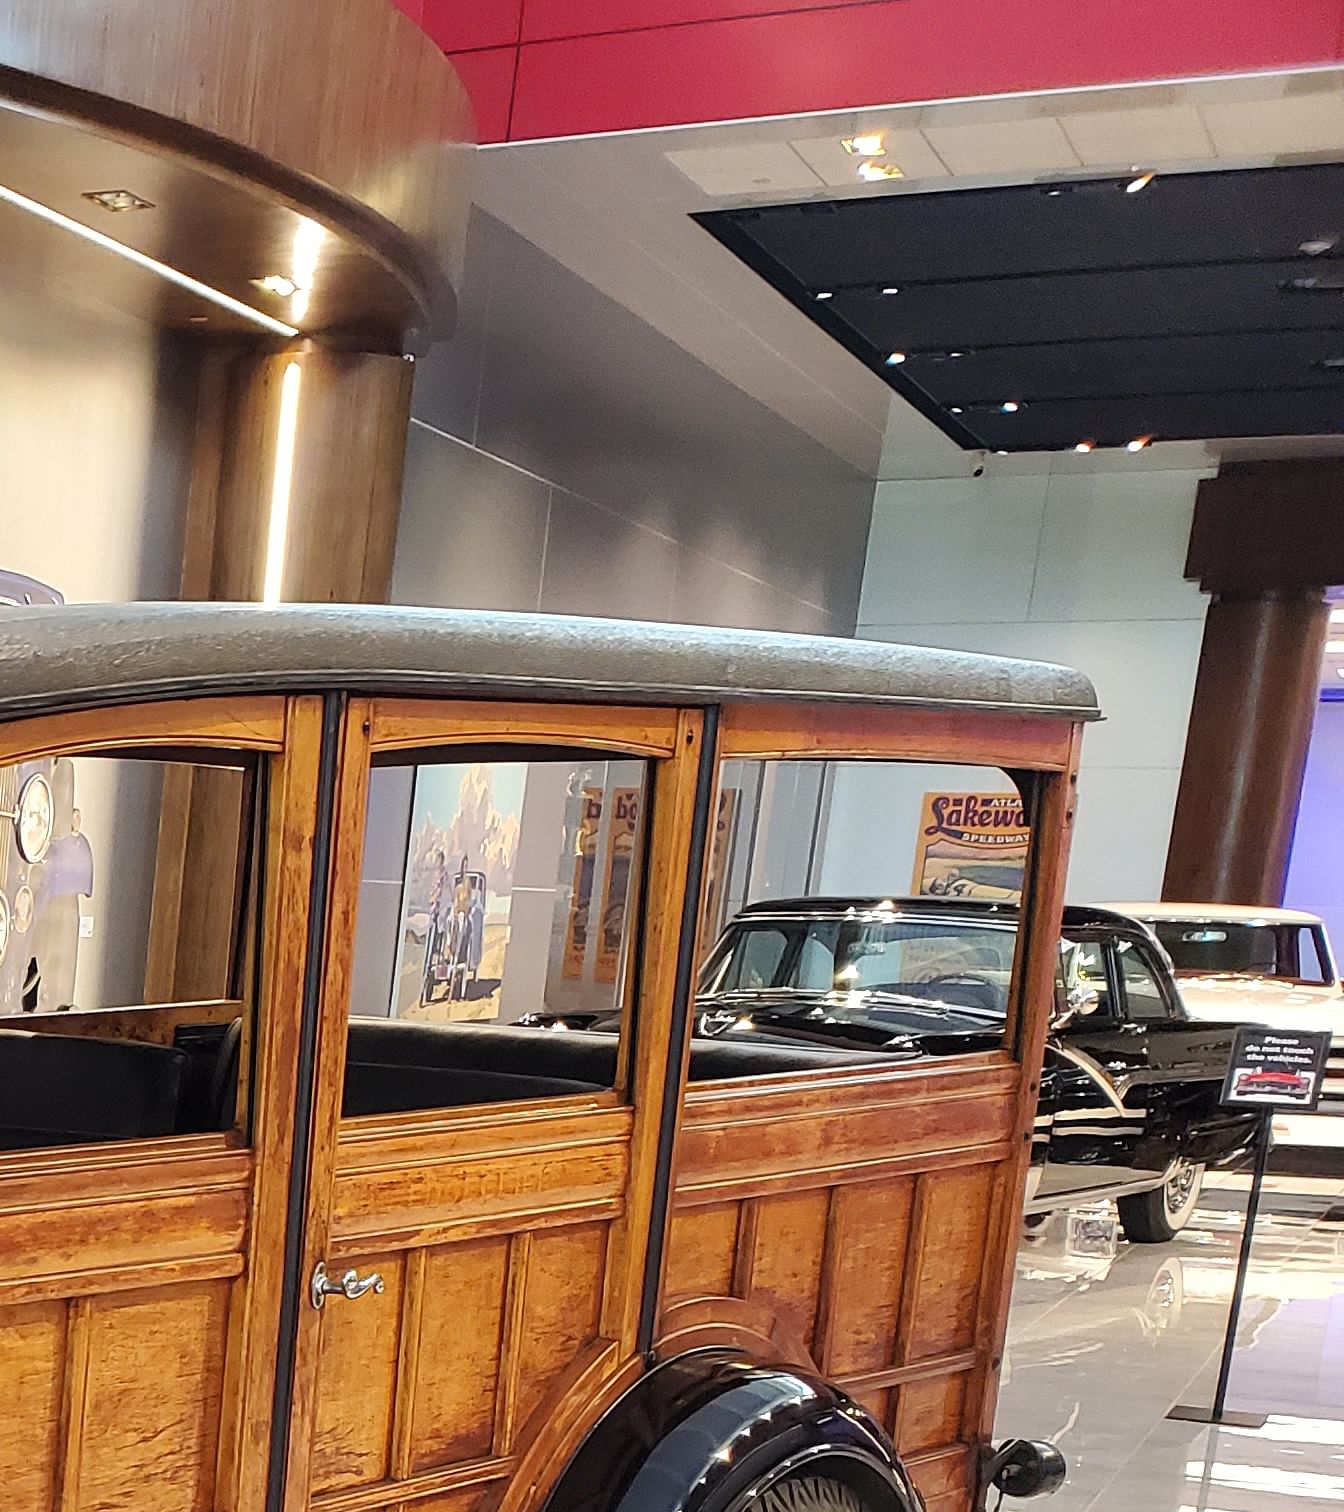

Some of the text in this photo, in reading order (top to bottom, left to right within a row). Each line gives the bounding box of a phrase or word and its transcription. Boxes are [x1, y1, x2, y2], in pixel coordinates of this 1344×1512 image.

[924, 796, 1030, 835] Lakewo
[962, 833, 1030, 843] SPEEDWAY
[1264, 1036, 1300, 1046] Please
[1245, 1044, 1261, 1053] do
[1246, 1053, 1265, 1061] the
